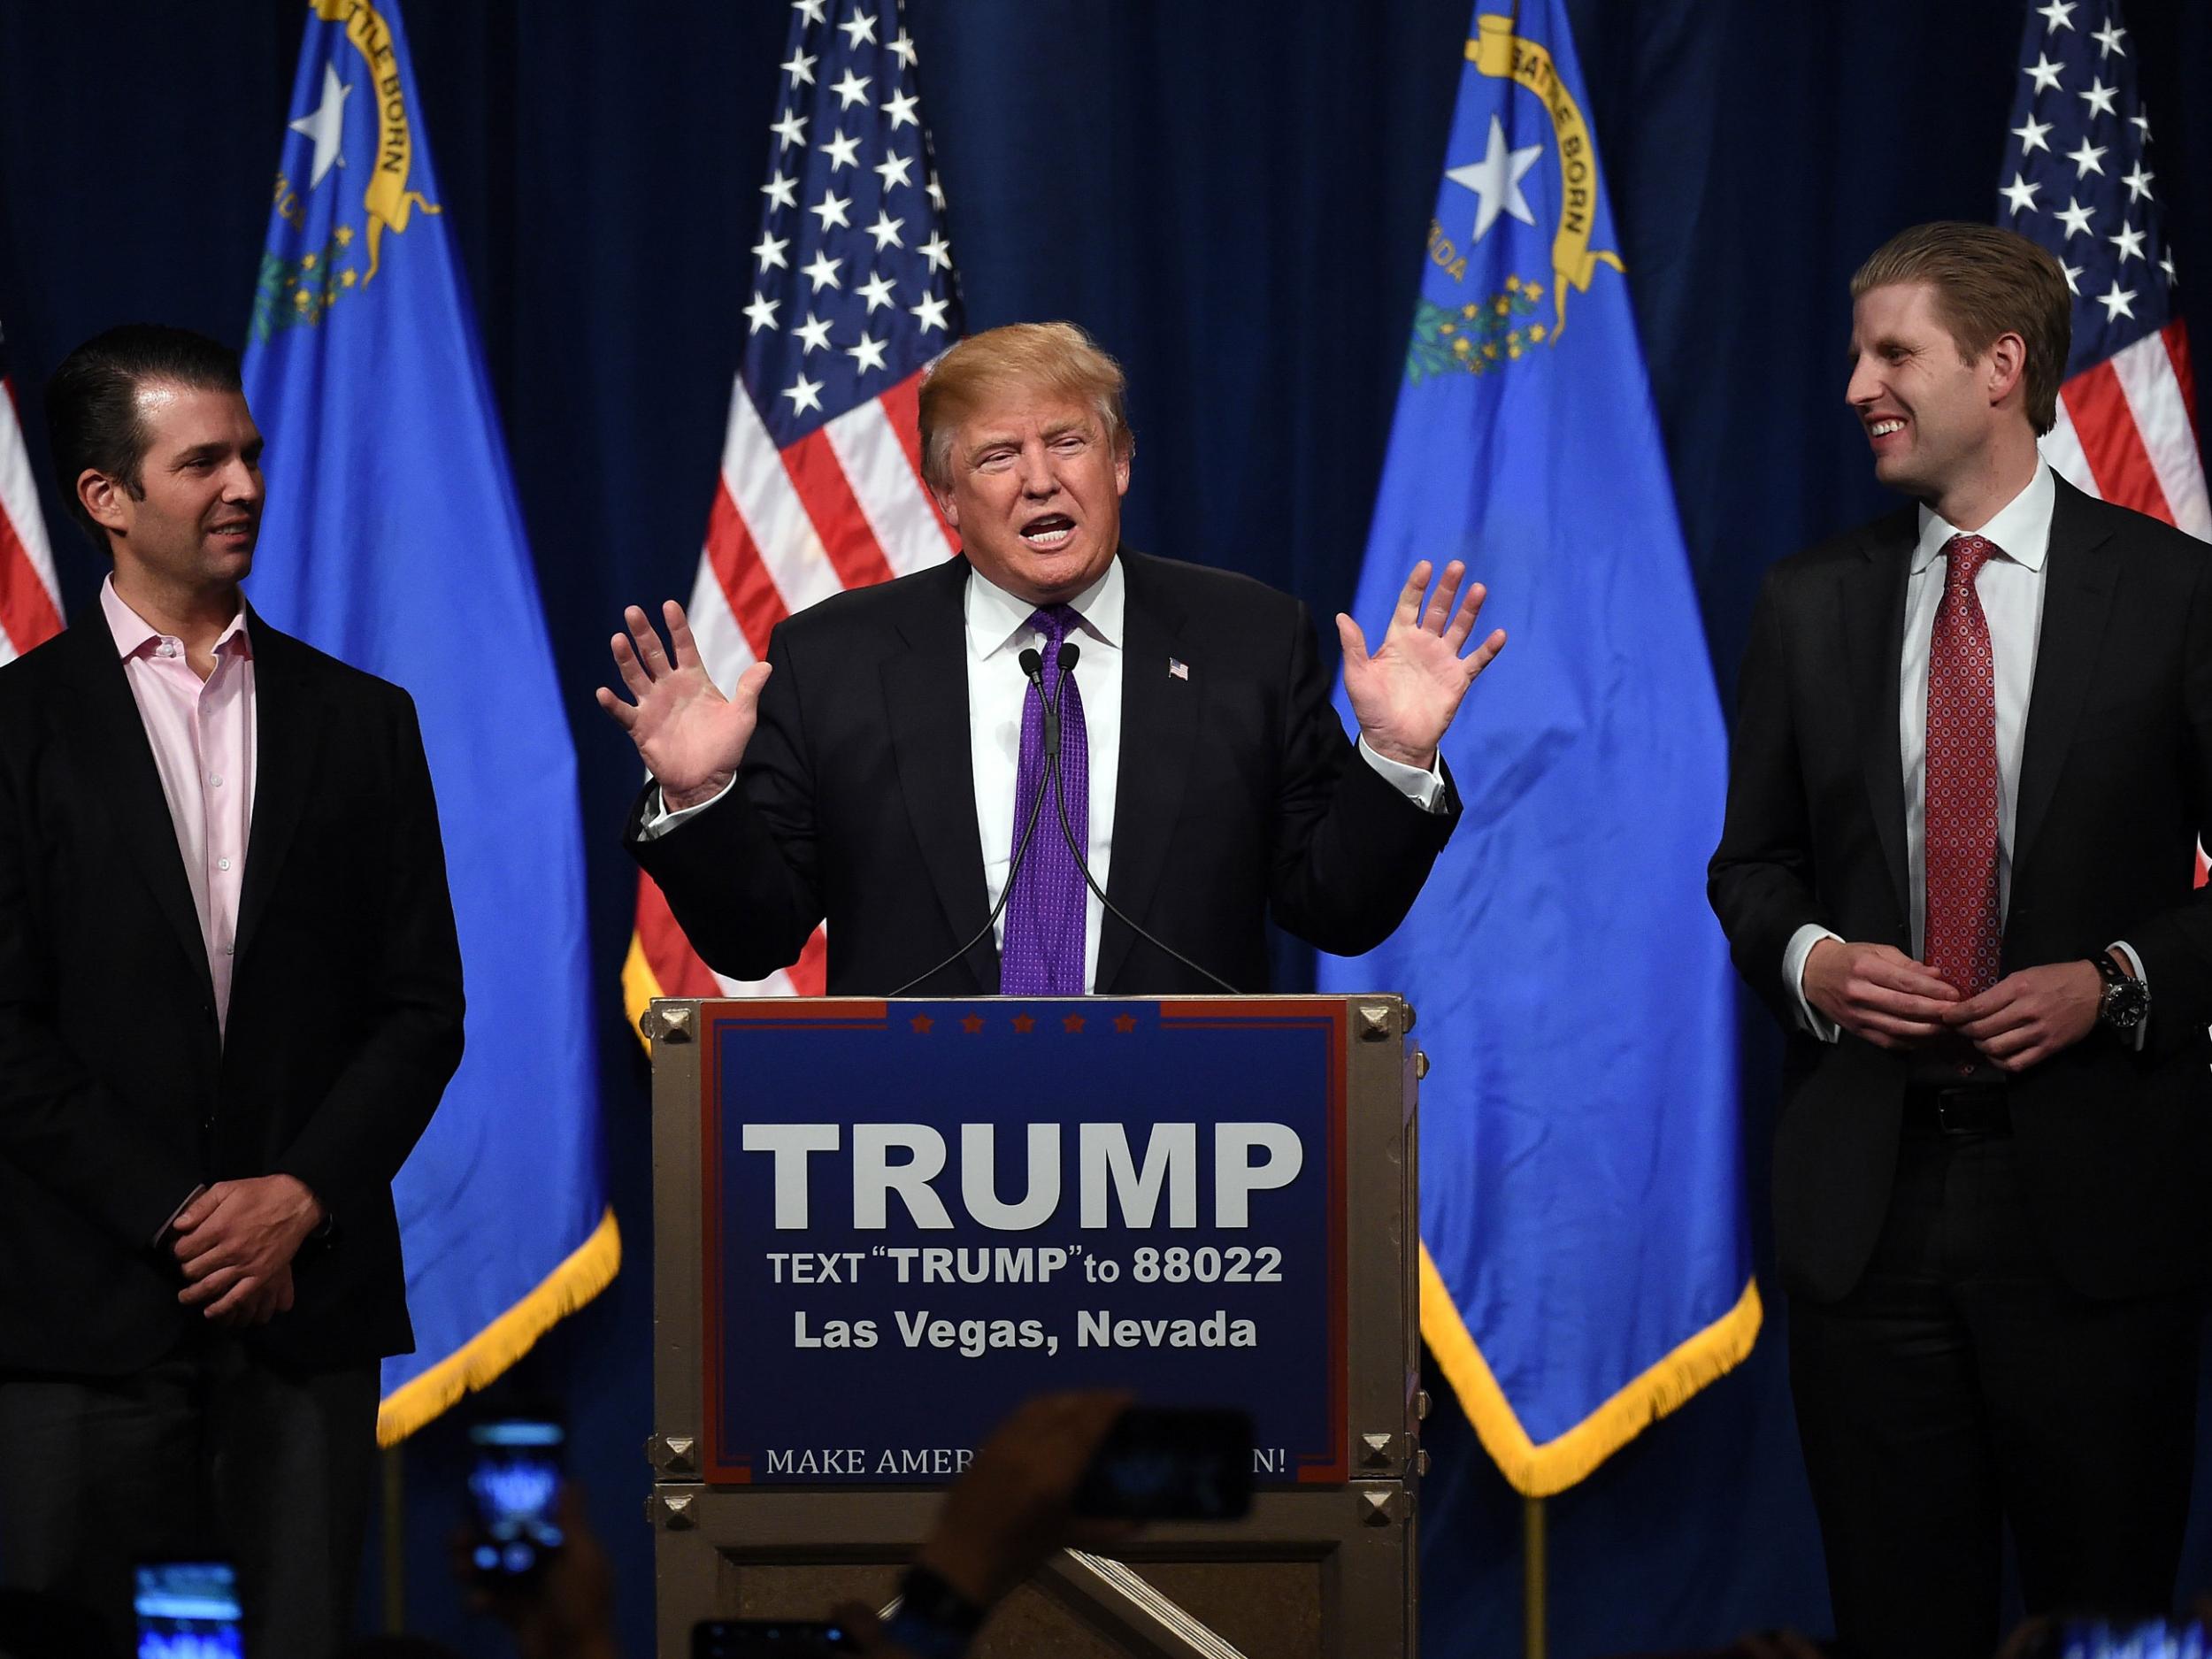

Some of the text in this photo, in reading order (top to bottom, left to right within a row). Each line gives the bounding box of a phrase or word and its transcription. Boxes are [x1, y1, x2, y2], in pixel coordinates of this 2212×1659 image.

[380, 74, 406, 173] BORN
[1561, 135, 1587, 234] BORN
[742, 1122, 1303, 1231] TRUMP
[767, 1253, 866, 1284] TEXT
[1084, 1253, 1120, 1283] to
[1133, 1246, 1282, 1283] 88022
[795, 1310, 1257, 1358] Las Vegas, Nevada
[766, 1449, 975, 1474] MAKE AMER
